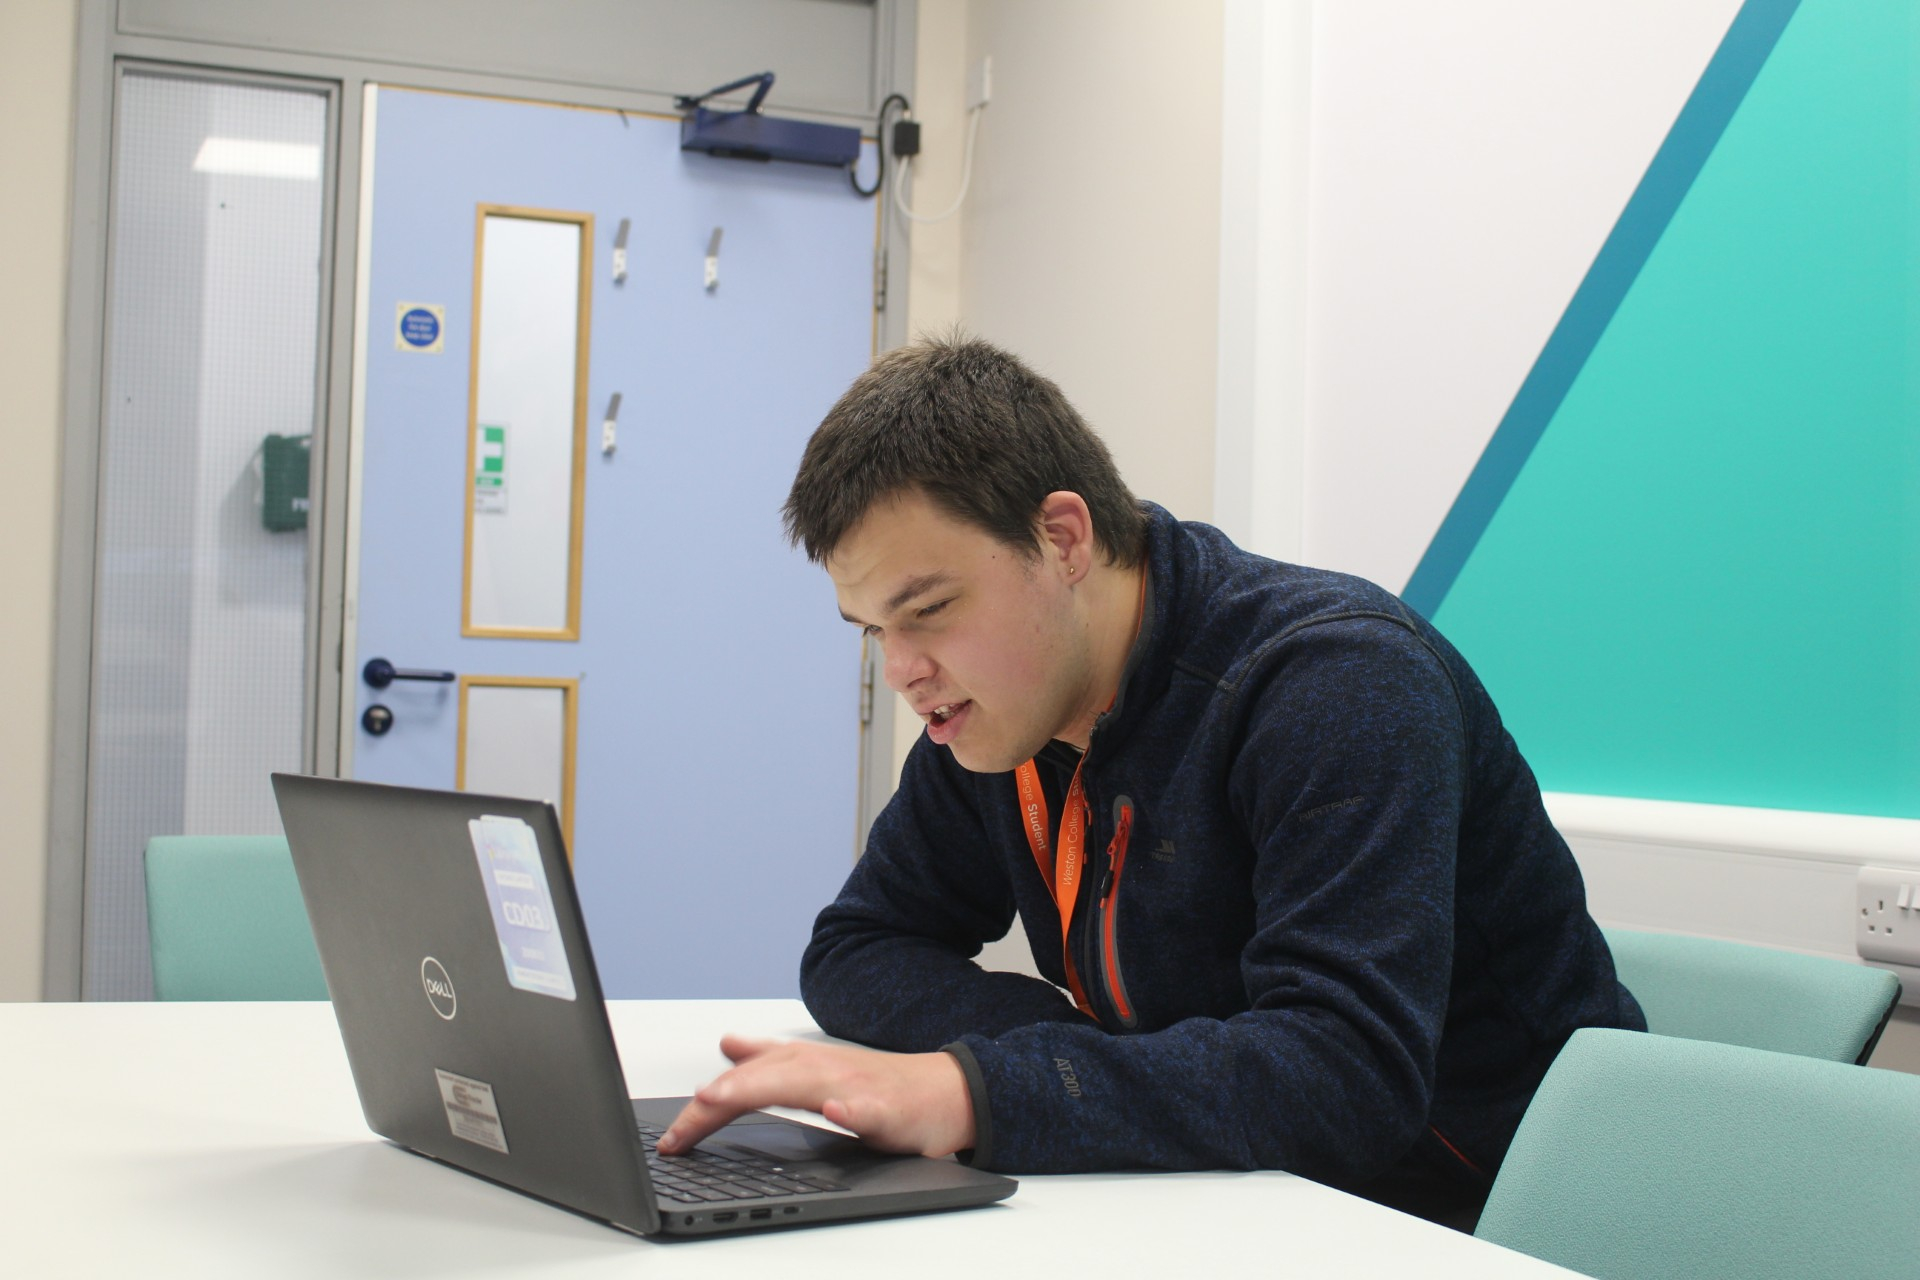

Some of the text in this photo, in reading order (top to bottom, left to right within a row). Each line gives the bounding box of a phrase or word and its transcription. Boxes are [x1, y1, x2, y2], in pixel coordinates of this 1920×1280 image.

[1019, 761, 1047, 851] ollege Student
[1067, 800, 1081, 844] College
[1062, 845, 1077, 886] Weston
[502, 900, 546, 930] CD03
[425, 977, 453, 999] DELL
[1052, 1057, 1082, 1098] AT300
